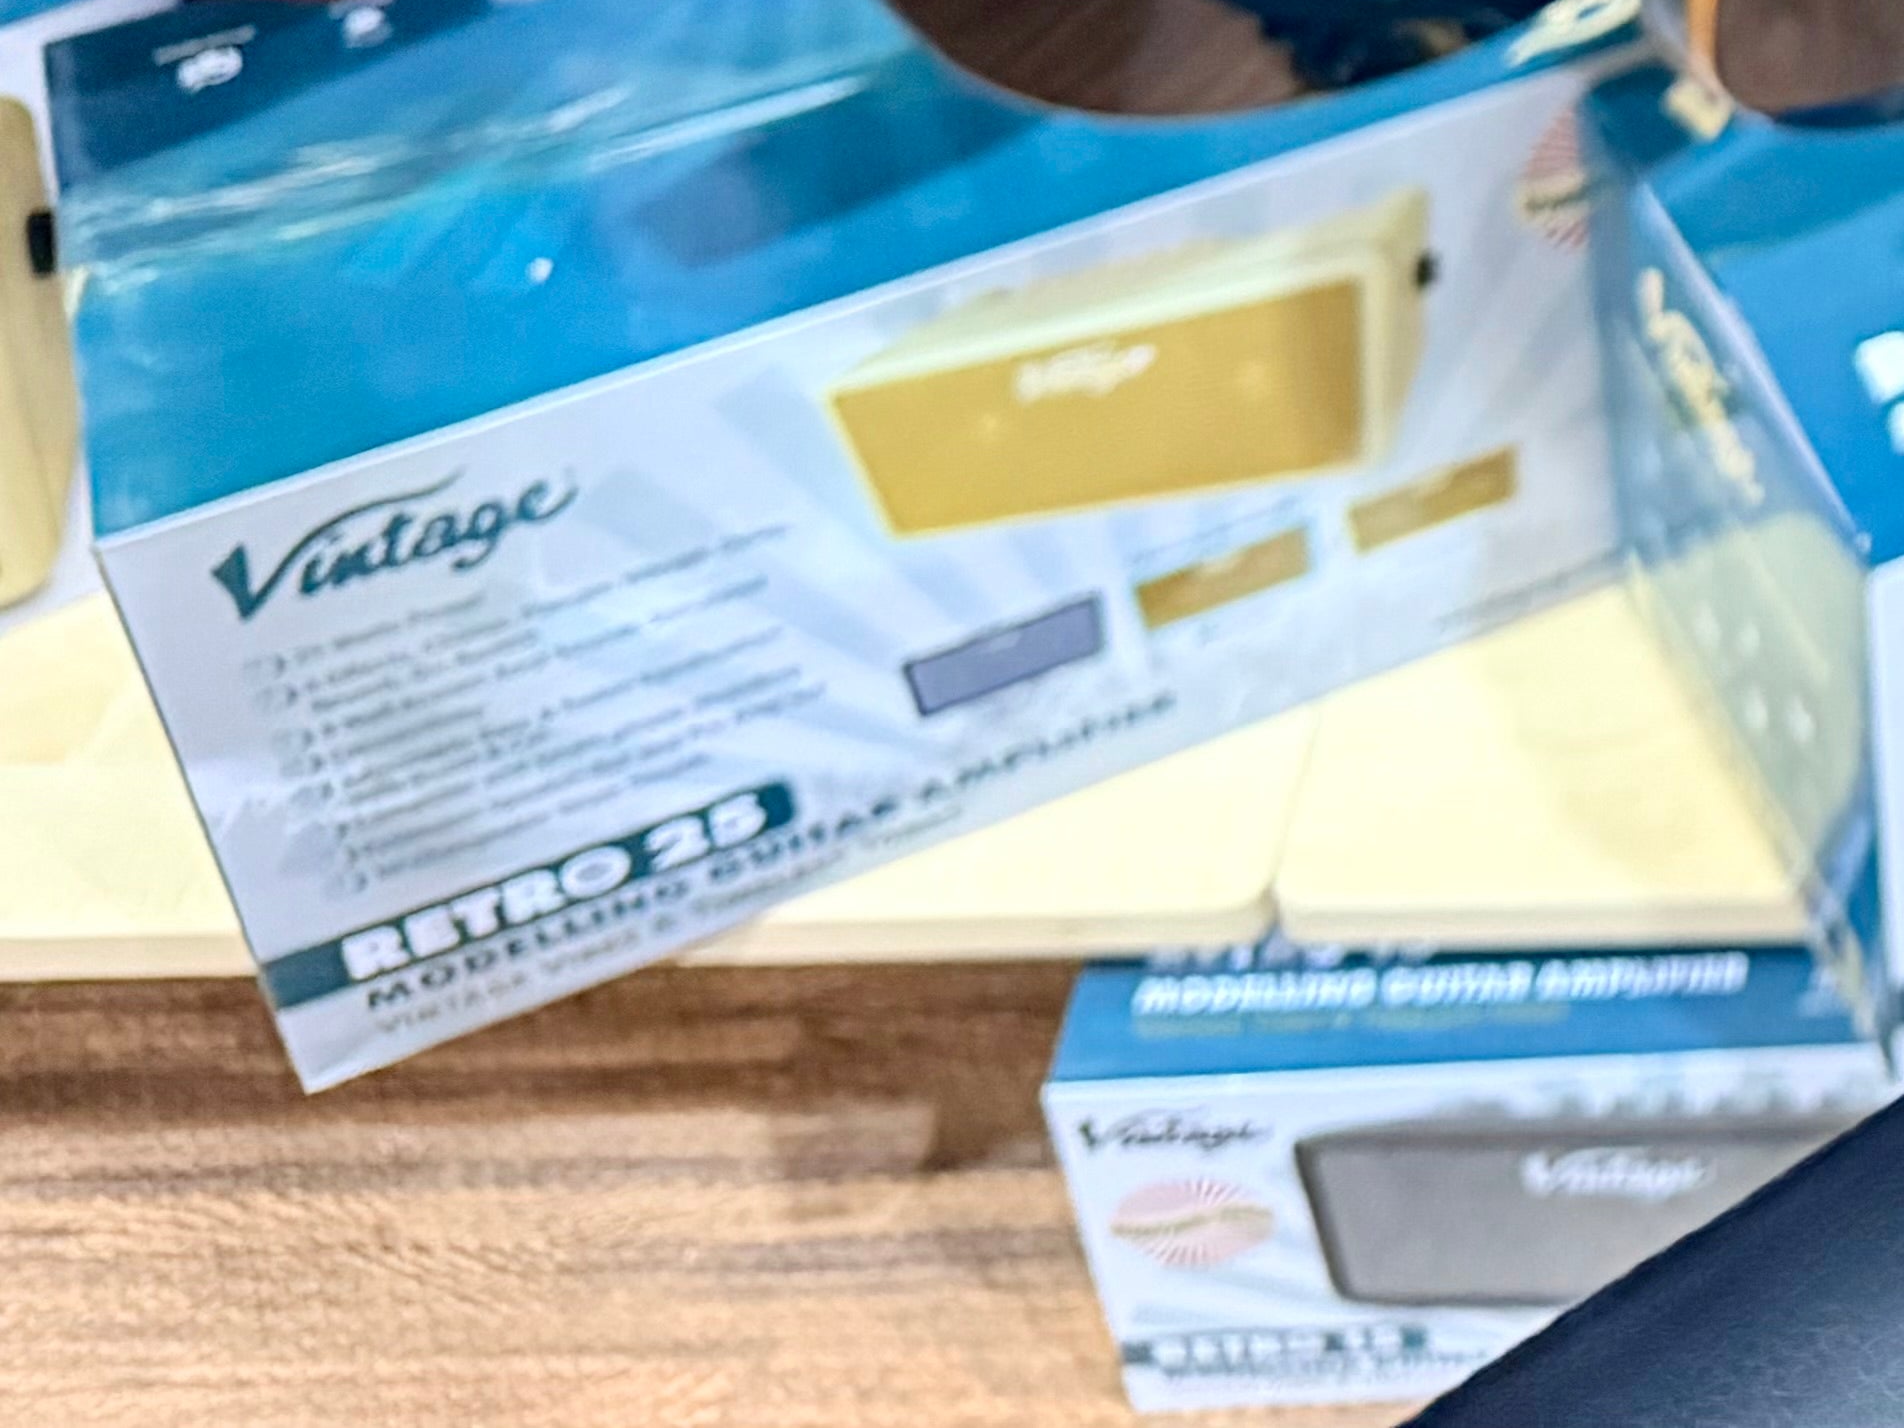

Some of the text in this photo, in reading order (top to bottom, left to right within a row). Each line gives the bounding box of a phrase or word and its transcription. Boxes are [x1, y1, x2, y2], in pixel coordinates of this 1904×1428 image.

[211, 463, 579, 622] Vintage
[341, 845, 632, 982] RETRO
[643, 791, 768, 875] 25
[366, 877, 690, 1011] MODELLING
